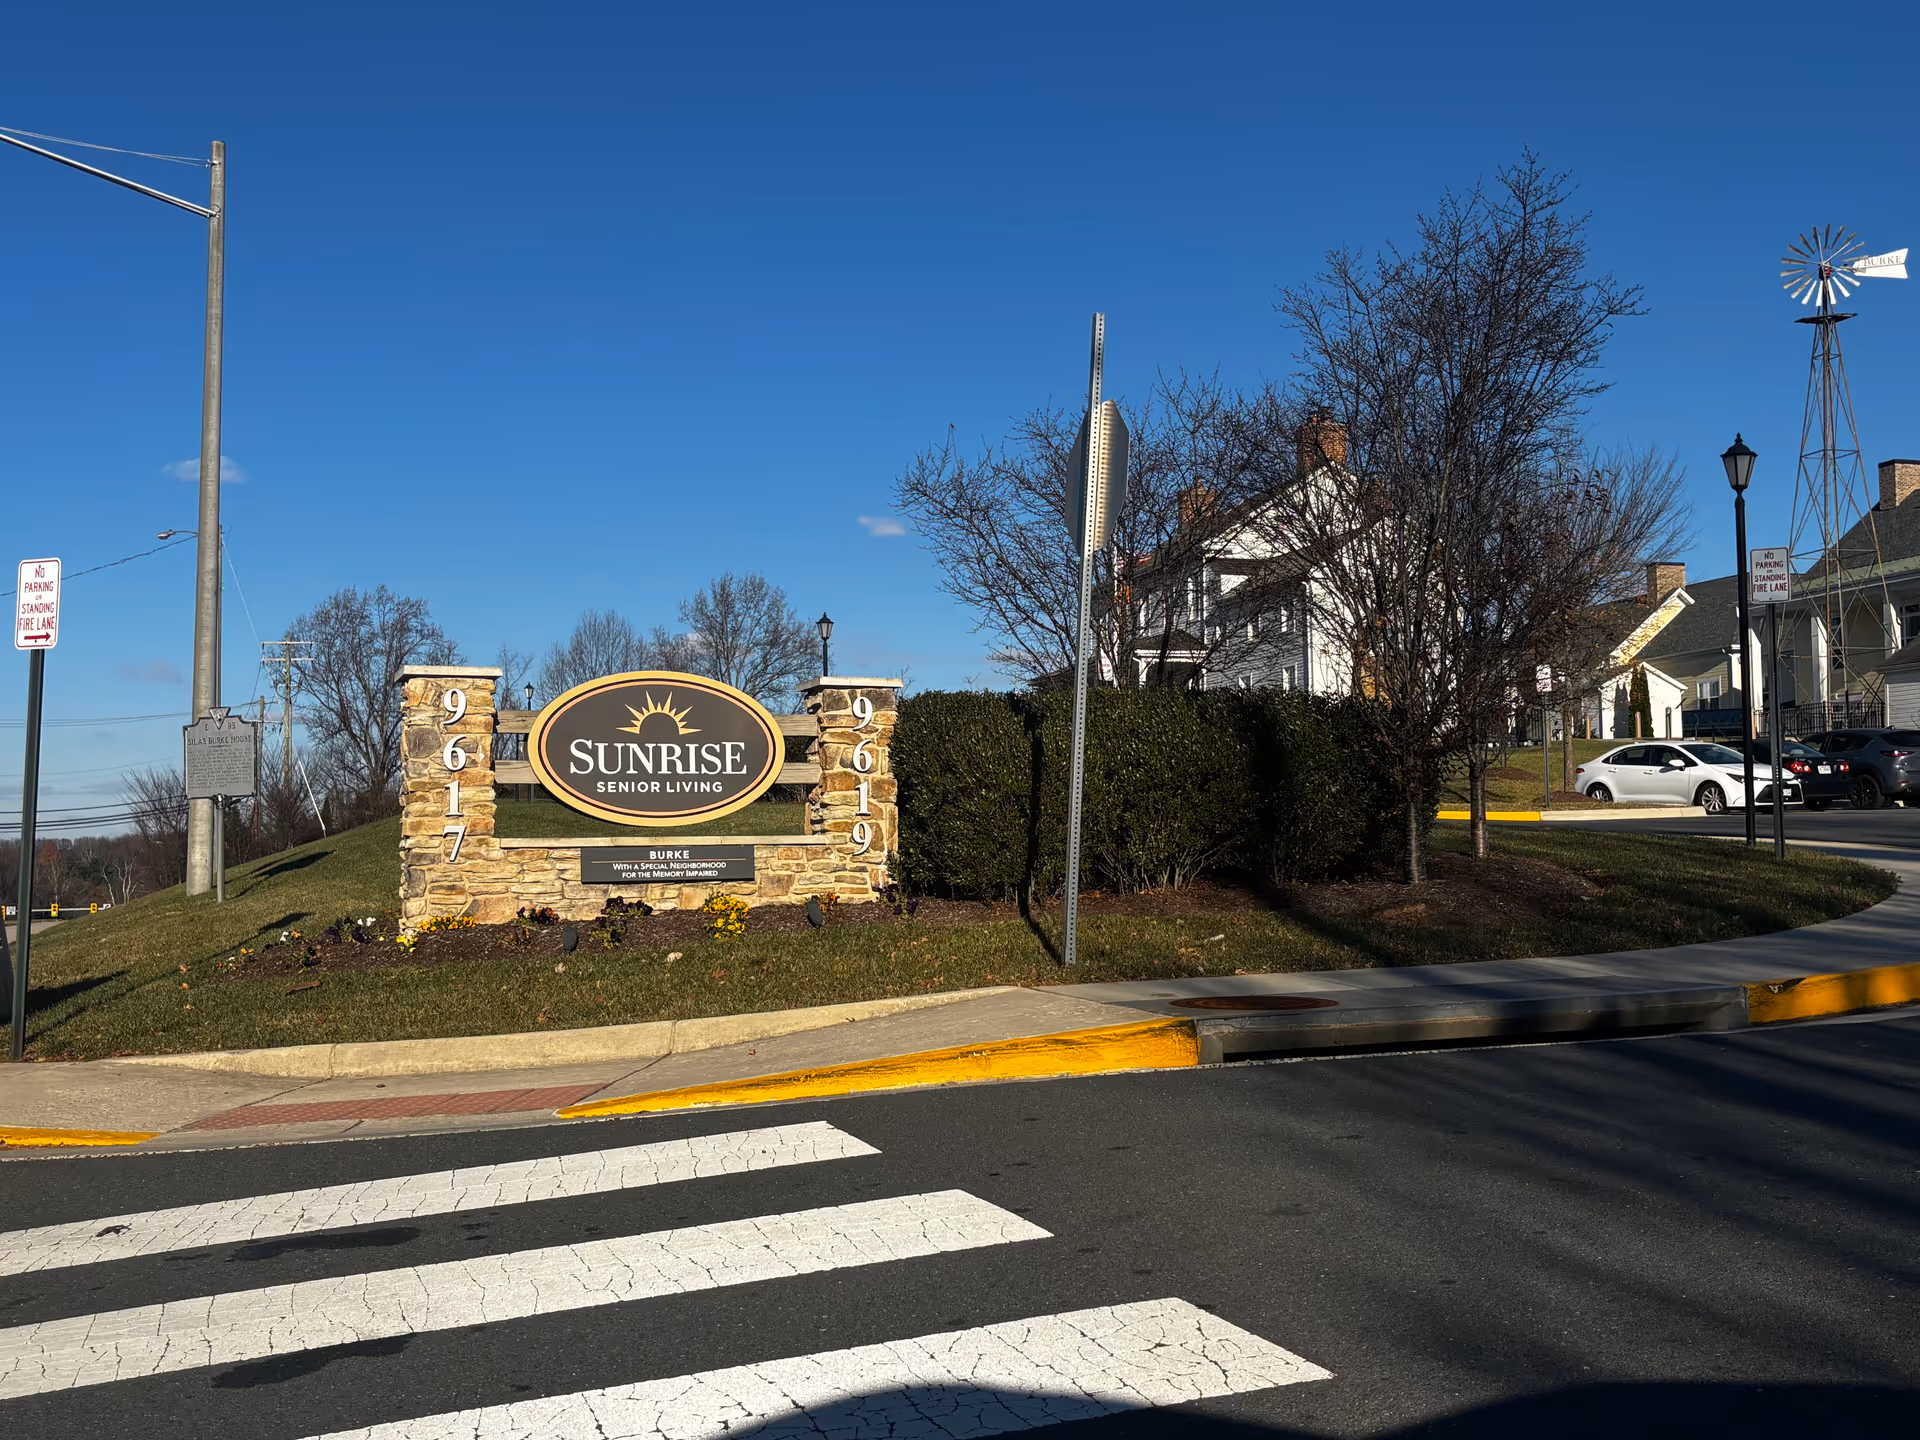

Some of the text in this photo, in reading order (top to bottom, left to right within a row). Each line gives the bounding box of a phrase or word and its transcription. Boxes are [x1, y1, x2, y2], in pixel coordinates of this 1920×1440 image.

[1864, 255, 1903, 267] BURKE
[1764, 552, 1774, 560] NO
[1755, 561, 1784, 569] PARKING
[34, 567, 45, 578] NO
[1754, 574, 1786, 582] STANDING
[24, 581, 54, 593] PARKING
[1753, 582, 1788, 593] FIRE LANE
[21, 602, 55, 614] STANDING
[18, 616, 55, 632] FIRE LANE
[187, 735, 252, 746] SILAS BURKE HOUSE
[569, 738, 748, 775] SUNRISE
[596, 781, 723, 793] SENIOR LIVING
[649, 850, 690, 860] BURKE
[640, 862, 669, 870] SPECIAL
[670, 861, 727, 869] NEIGHBORHOOD
[622, 871, 637, 879] FOR
[652, 870, 684, 878] MEMORY
[685, 869, 719, 877] IMPAIRED
